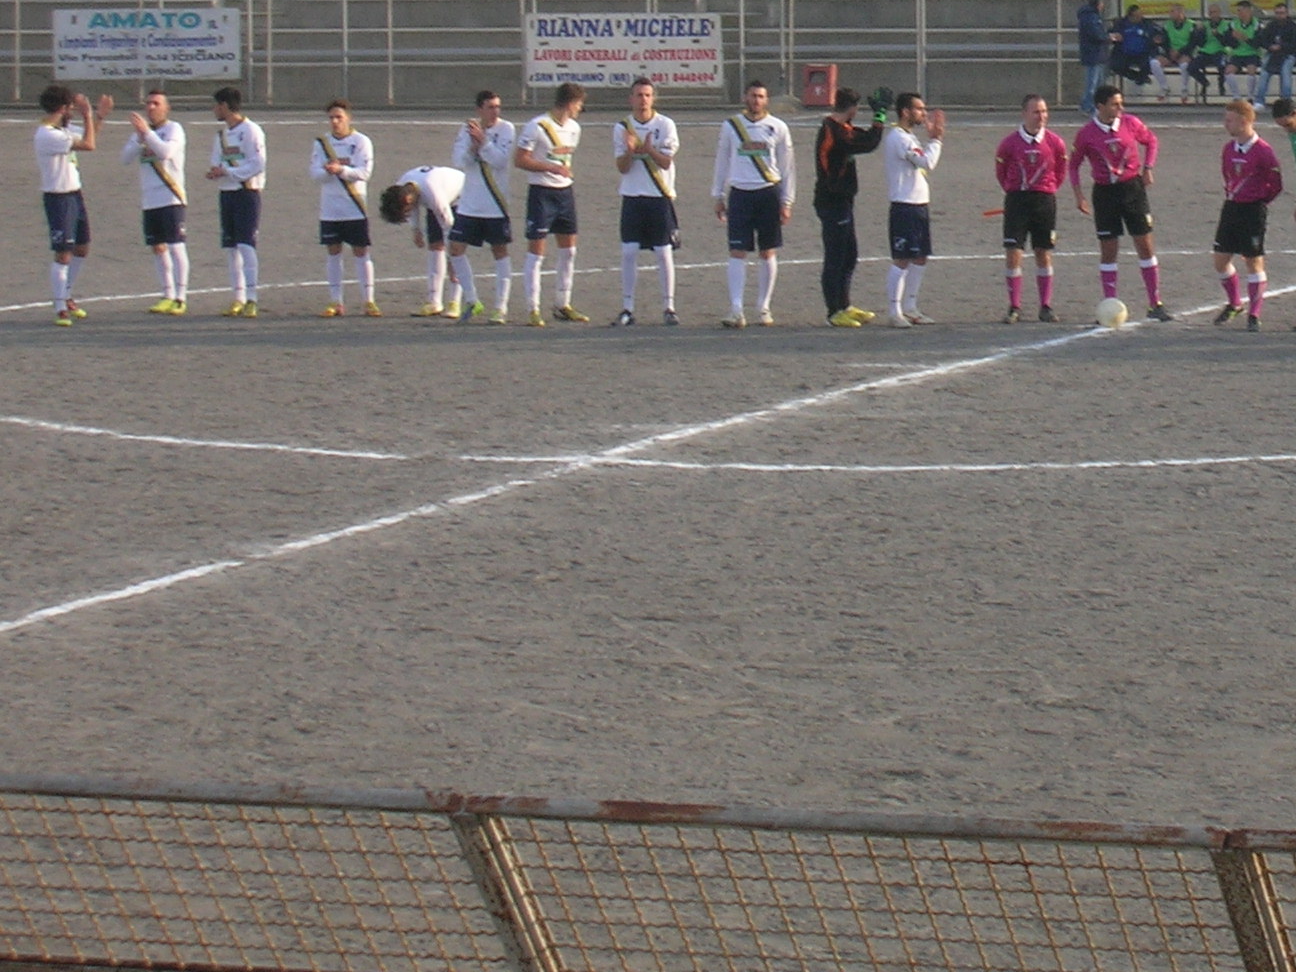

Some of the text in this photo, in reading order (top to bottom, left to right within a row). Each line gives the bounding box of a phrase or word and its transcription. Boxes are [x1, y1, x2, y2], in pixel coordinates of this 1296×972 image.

[87, 12, 201, 29] AMATO
[536, 18, 711, 38] RIANNA MICHELE
[533, 49, 572, 61] LAVORI
[574, 49, 628, 61] GENERALI
